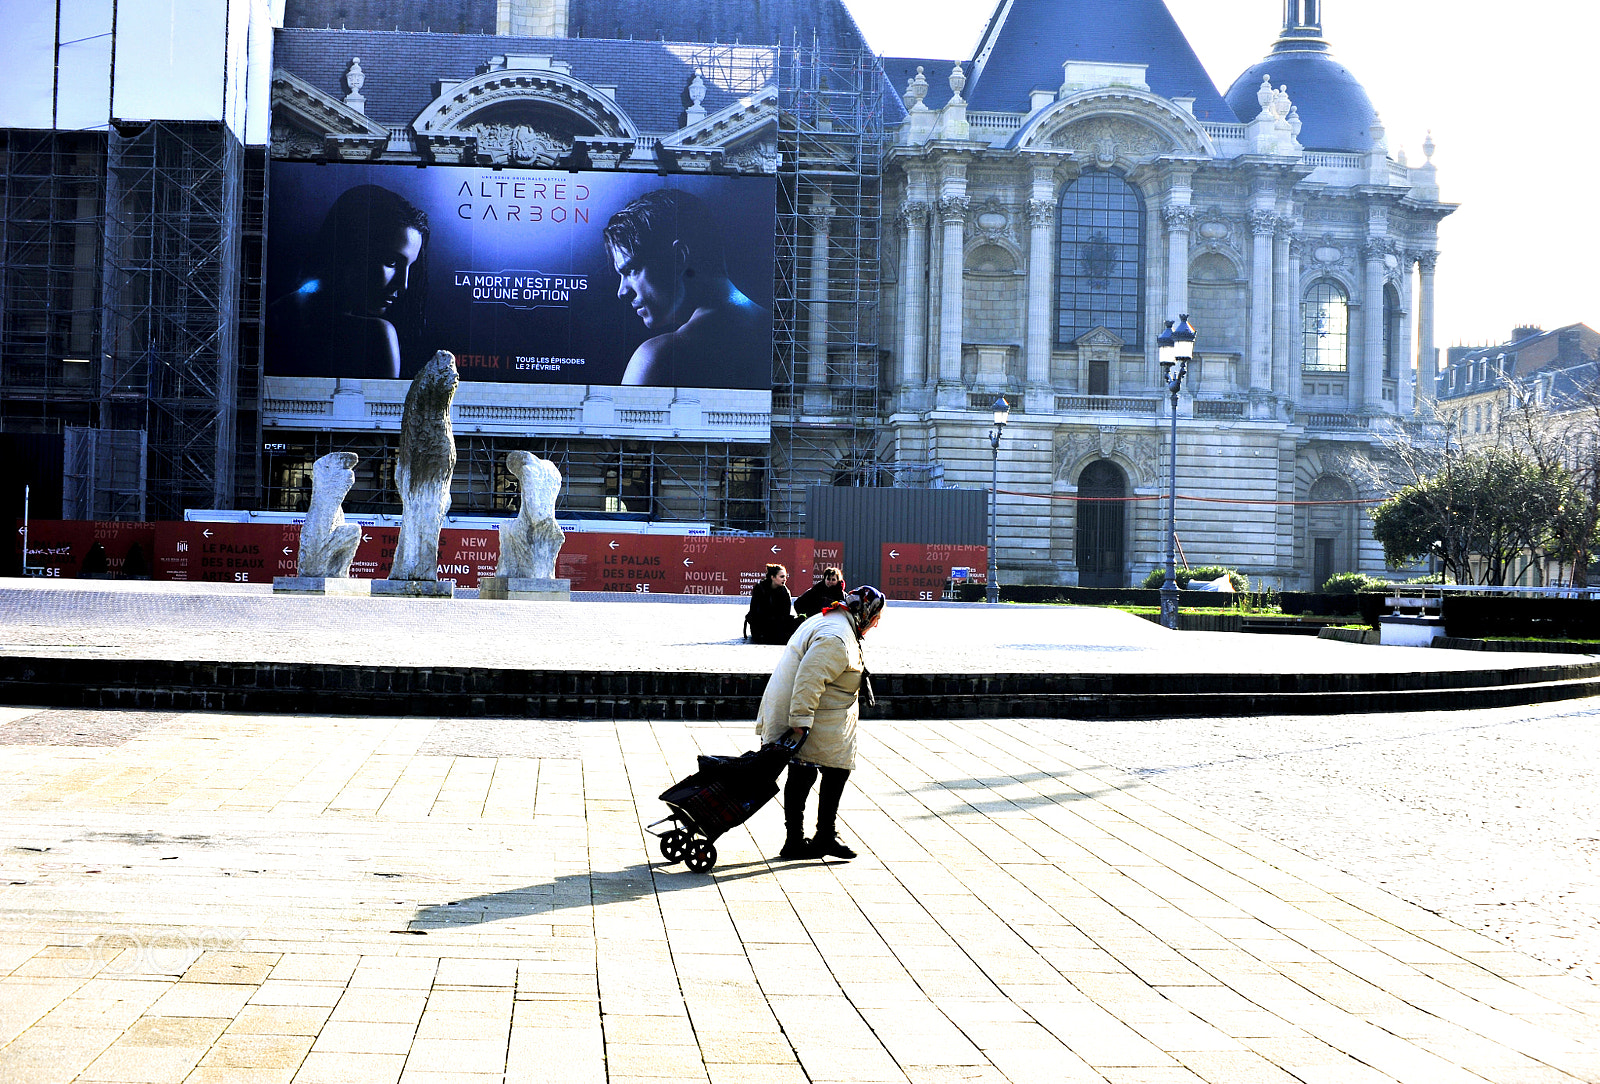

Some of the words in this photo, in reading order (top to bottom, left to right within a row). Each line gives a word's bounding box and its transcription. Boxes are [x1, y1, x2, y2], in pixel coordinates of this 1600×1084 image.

[458, 181, 590, 201] ALTERED
[458, 204, 589, 224] CARBON
[455, 275, 471, 286] LA
[474, 276, 511, 288] MORT
[514, 277, 551, 289] N'EST
[555, 278, 588, 290] PLUS
[472, 287, 519, 299] QU'UNE
[523, 289, 569, 301] OPTION
[455, 354, 499, 369] NETFLIX
[550, 356, 585, 365] ÉPISODES
[531, 363, 561, 371] FÉVRIER
[94, 530, 118, 539] 2017
[461, 537, 488, 547] NEW
[683, 536, 746, 544] PRINTEMPS
[203, 544, 217, 553] LE
[220, 544, 260, 554] PALAIS
[683, 544, 708, 553] 2017
[926, 544, 986, 552] PRINTEMPS
[454, 551, 497, 561] ATRIUM
[813, 549, 838, 558] NEW
[926, 552, 950, 561] 2017
[202, 558, 223, 567] DES
[227, 558, 265, 568] BEAUX
[604, 555, 618, 564] LE
[621, 555, 660, 565] PALAIS
[46, 568, 61, 577] SE
[437, 564, 470, 574] AVING
[889, 564, 902, 573] LE
[906, 564, 943, 573] PALAIS
[202, 572, 231, 581] ARTS
[234, 572, 249, 582] SE
[603, 569, 625, 578] DES
[628, 569, 666, 579] BEAUX
[685, 571, 728, 581] NOUVEL
[889, 577, 910, 586] DES
[603, 583, 632, 592] ARTS
[635, 583, 650, 593] SE
[683, 585, 724, 595] ATRIUM
[889, 590, 916, 600] ARTS
[919, 591, 933, 601] SE
